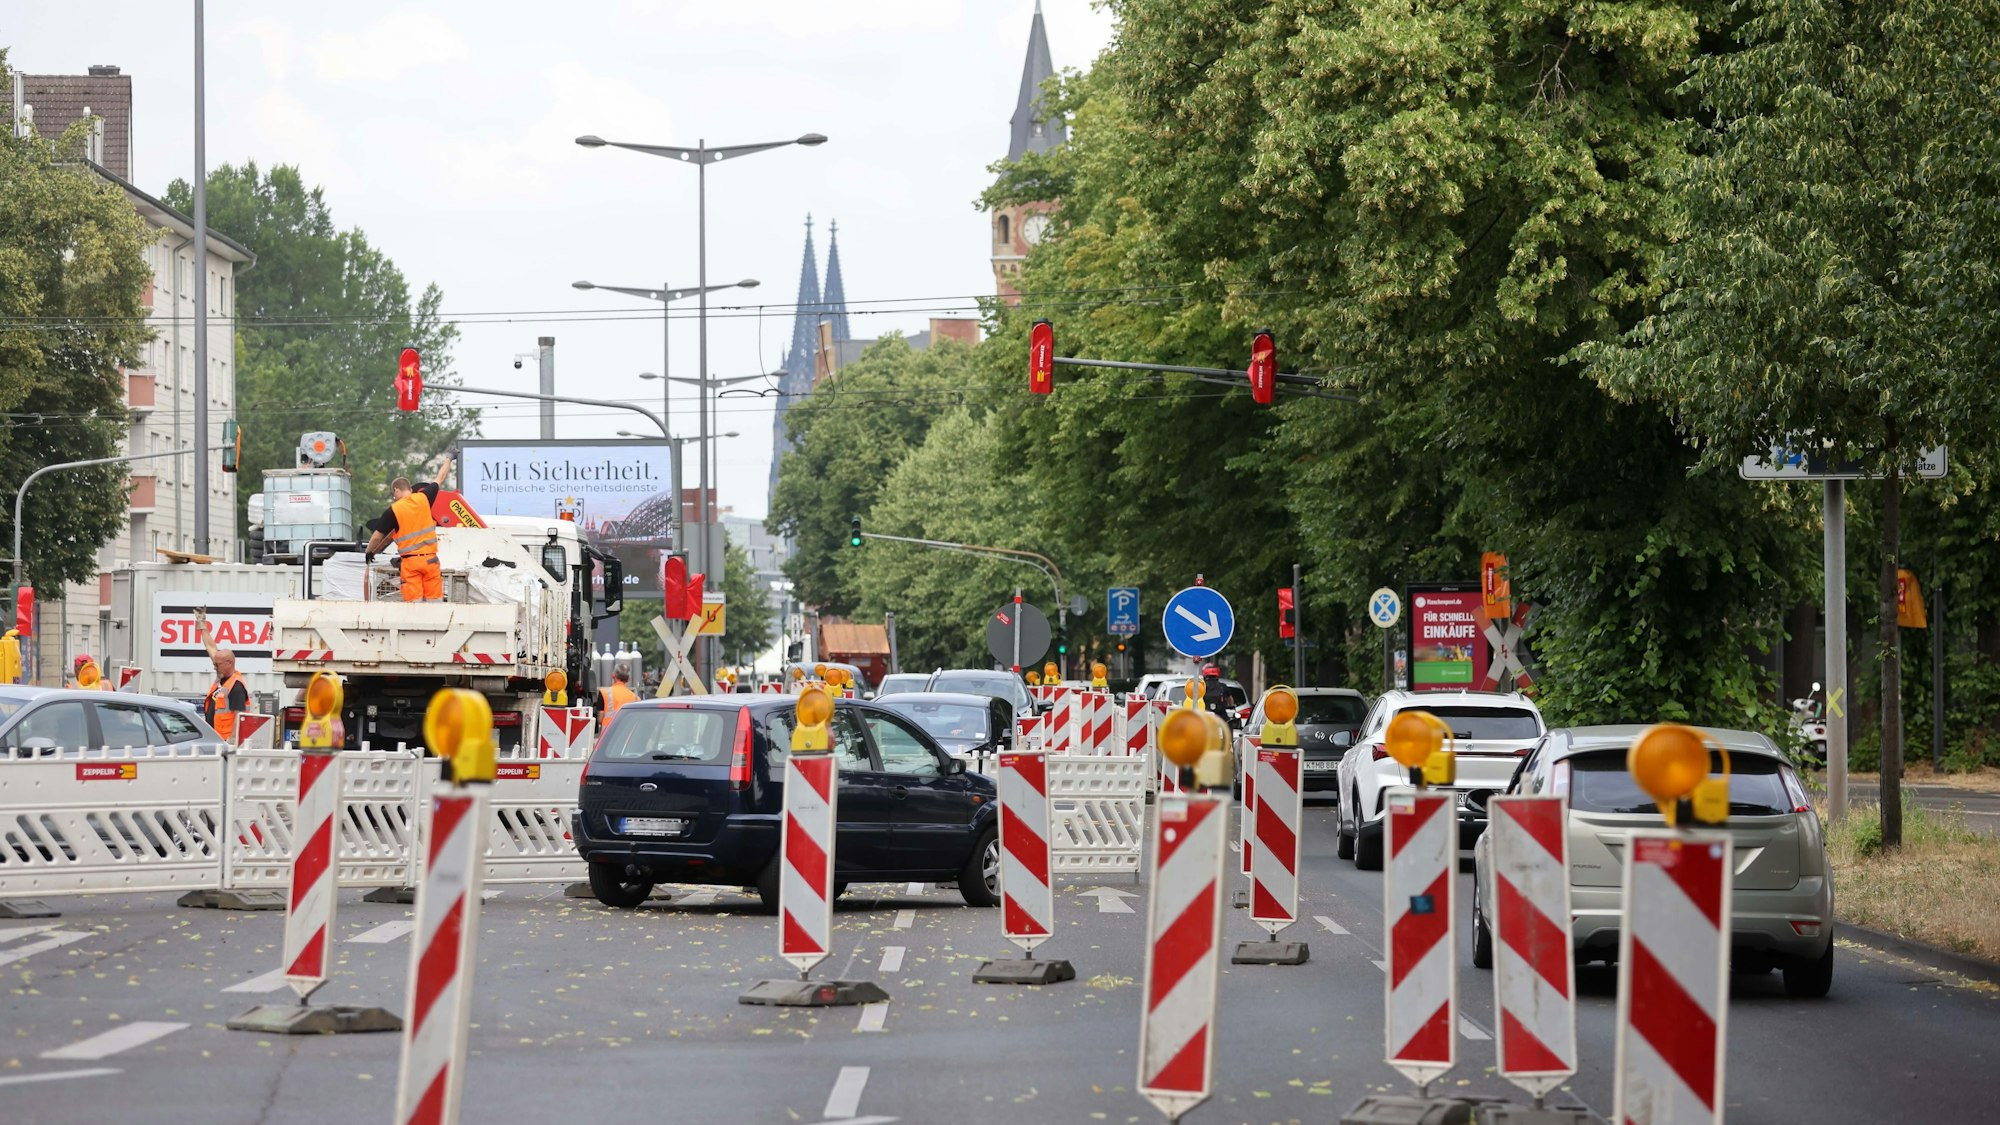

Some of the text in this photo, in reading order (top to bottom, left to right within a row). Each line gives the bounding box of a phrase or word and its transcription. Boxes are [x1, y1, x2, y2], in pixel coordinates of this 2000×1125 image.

[481, 460, 658, 481] Mit Sicherheit.
[481, 483, 658, 493] Rheinische Sicherheitsdienste
[1423, 611, 1438, 622] FÜR
[160, 619, 273, 645] STRABA
[1423, 622, 1476, 639] EINKÄUFE
[83, 768, 116, 776] ZEPPELIN
[497, 768, 524, 776] ZEPPELIN
